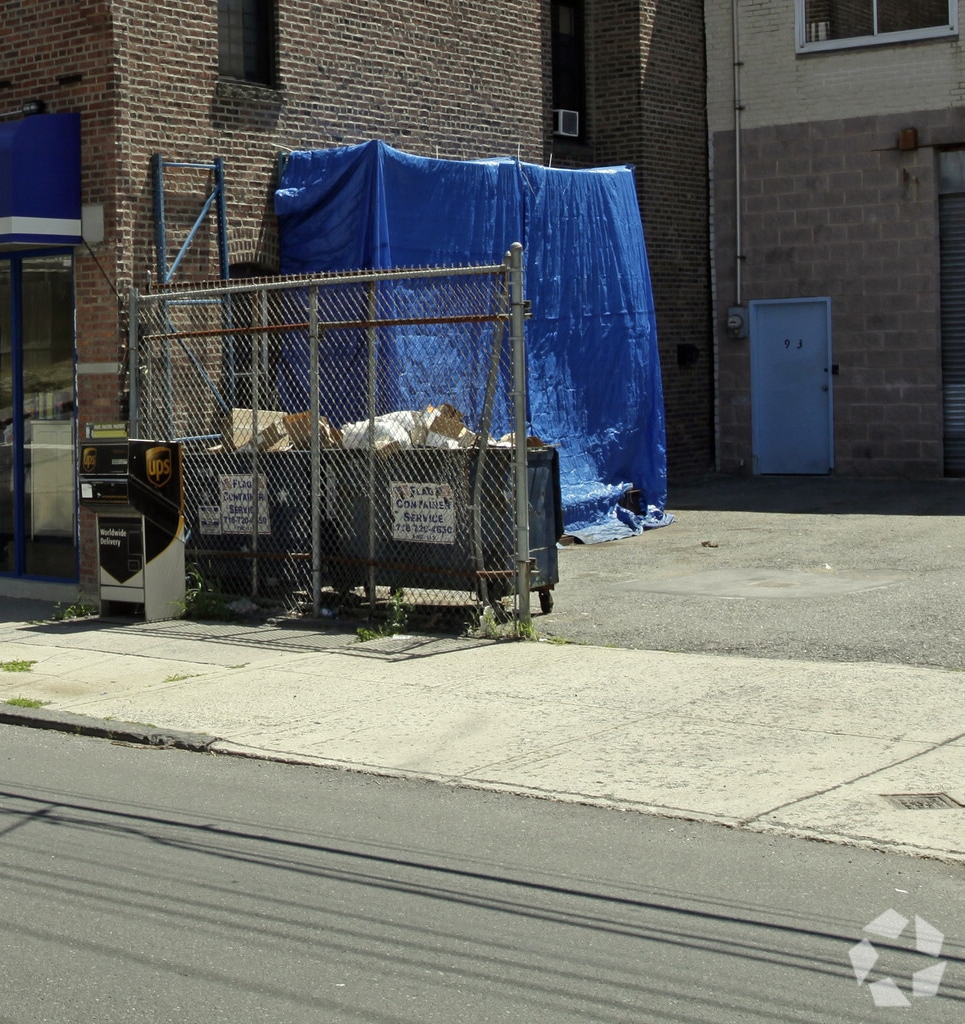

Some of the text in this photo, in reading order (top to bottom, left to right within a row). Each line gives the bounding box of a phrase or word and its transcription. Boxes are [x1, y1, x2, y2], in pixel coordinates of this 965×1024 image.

[147, 459, 171, 482] ups
[403, 512, 444, 523] SERVICE
[100, 528, 127, 537] Worldwide
[100, 537, 121, 548] Delivery
